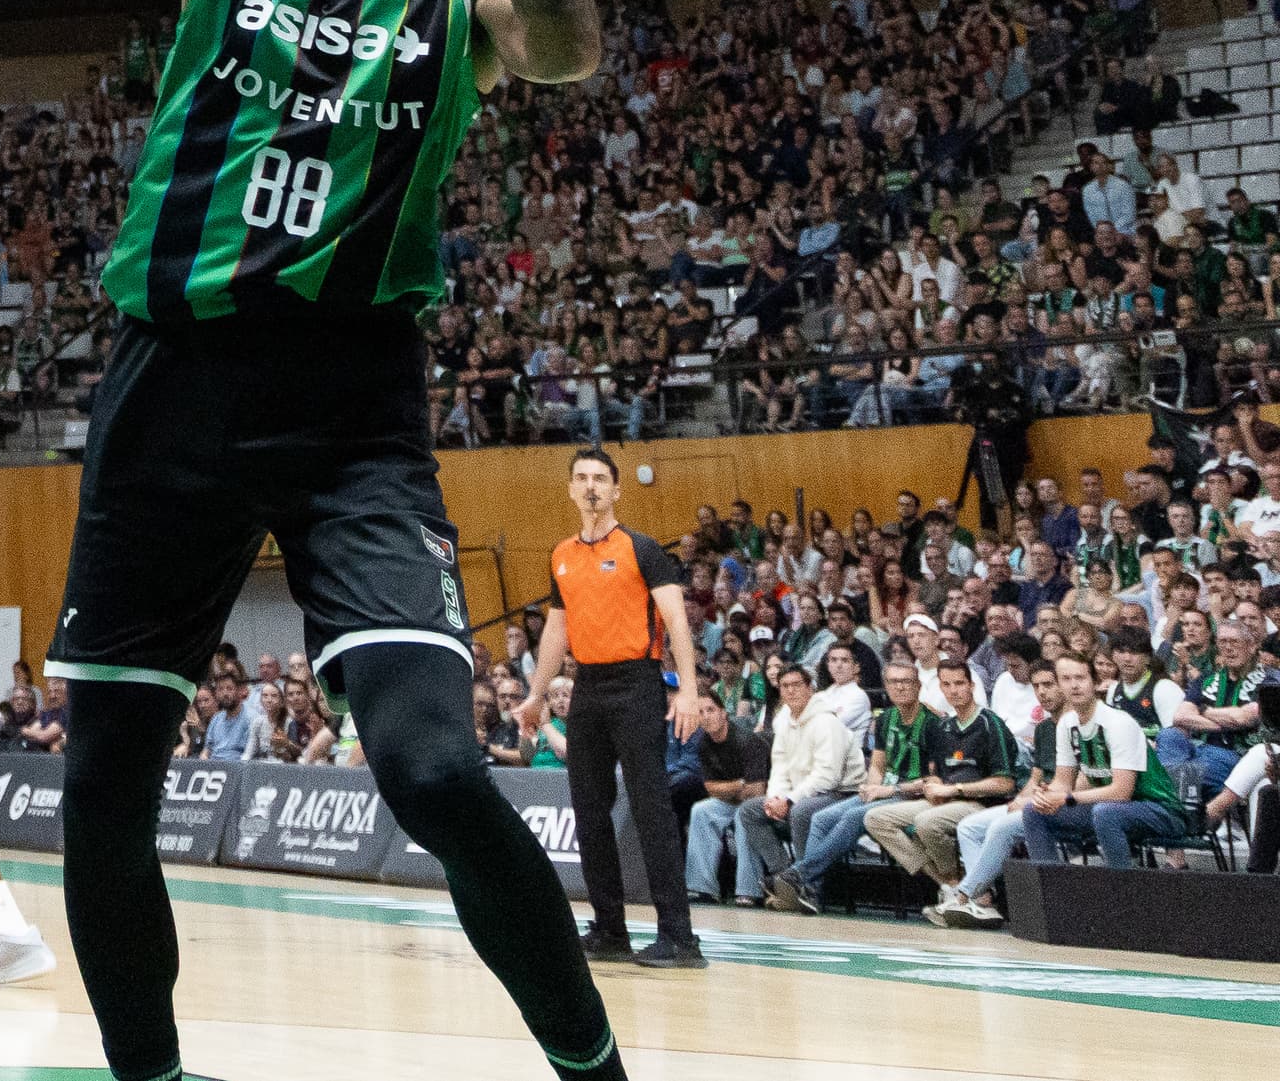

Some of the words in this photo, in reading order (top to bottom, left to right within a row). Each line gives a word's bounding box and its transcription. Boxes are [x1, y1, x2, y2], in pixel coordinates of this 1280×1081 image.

[212, 56, 425, 132] JOVENTUT
[241, 146, 333, 239] 88
[276, 787, 380, 834] RAGVSA
